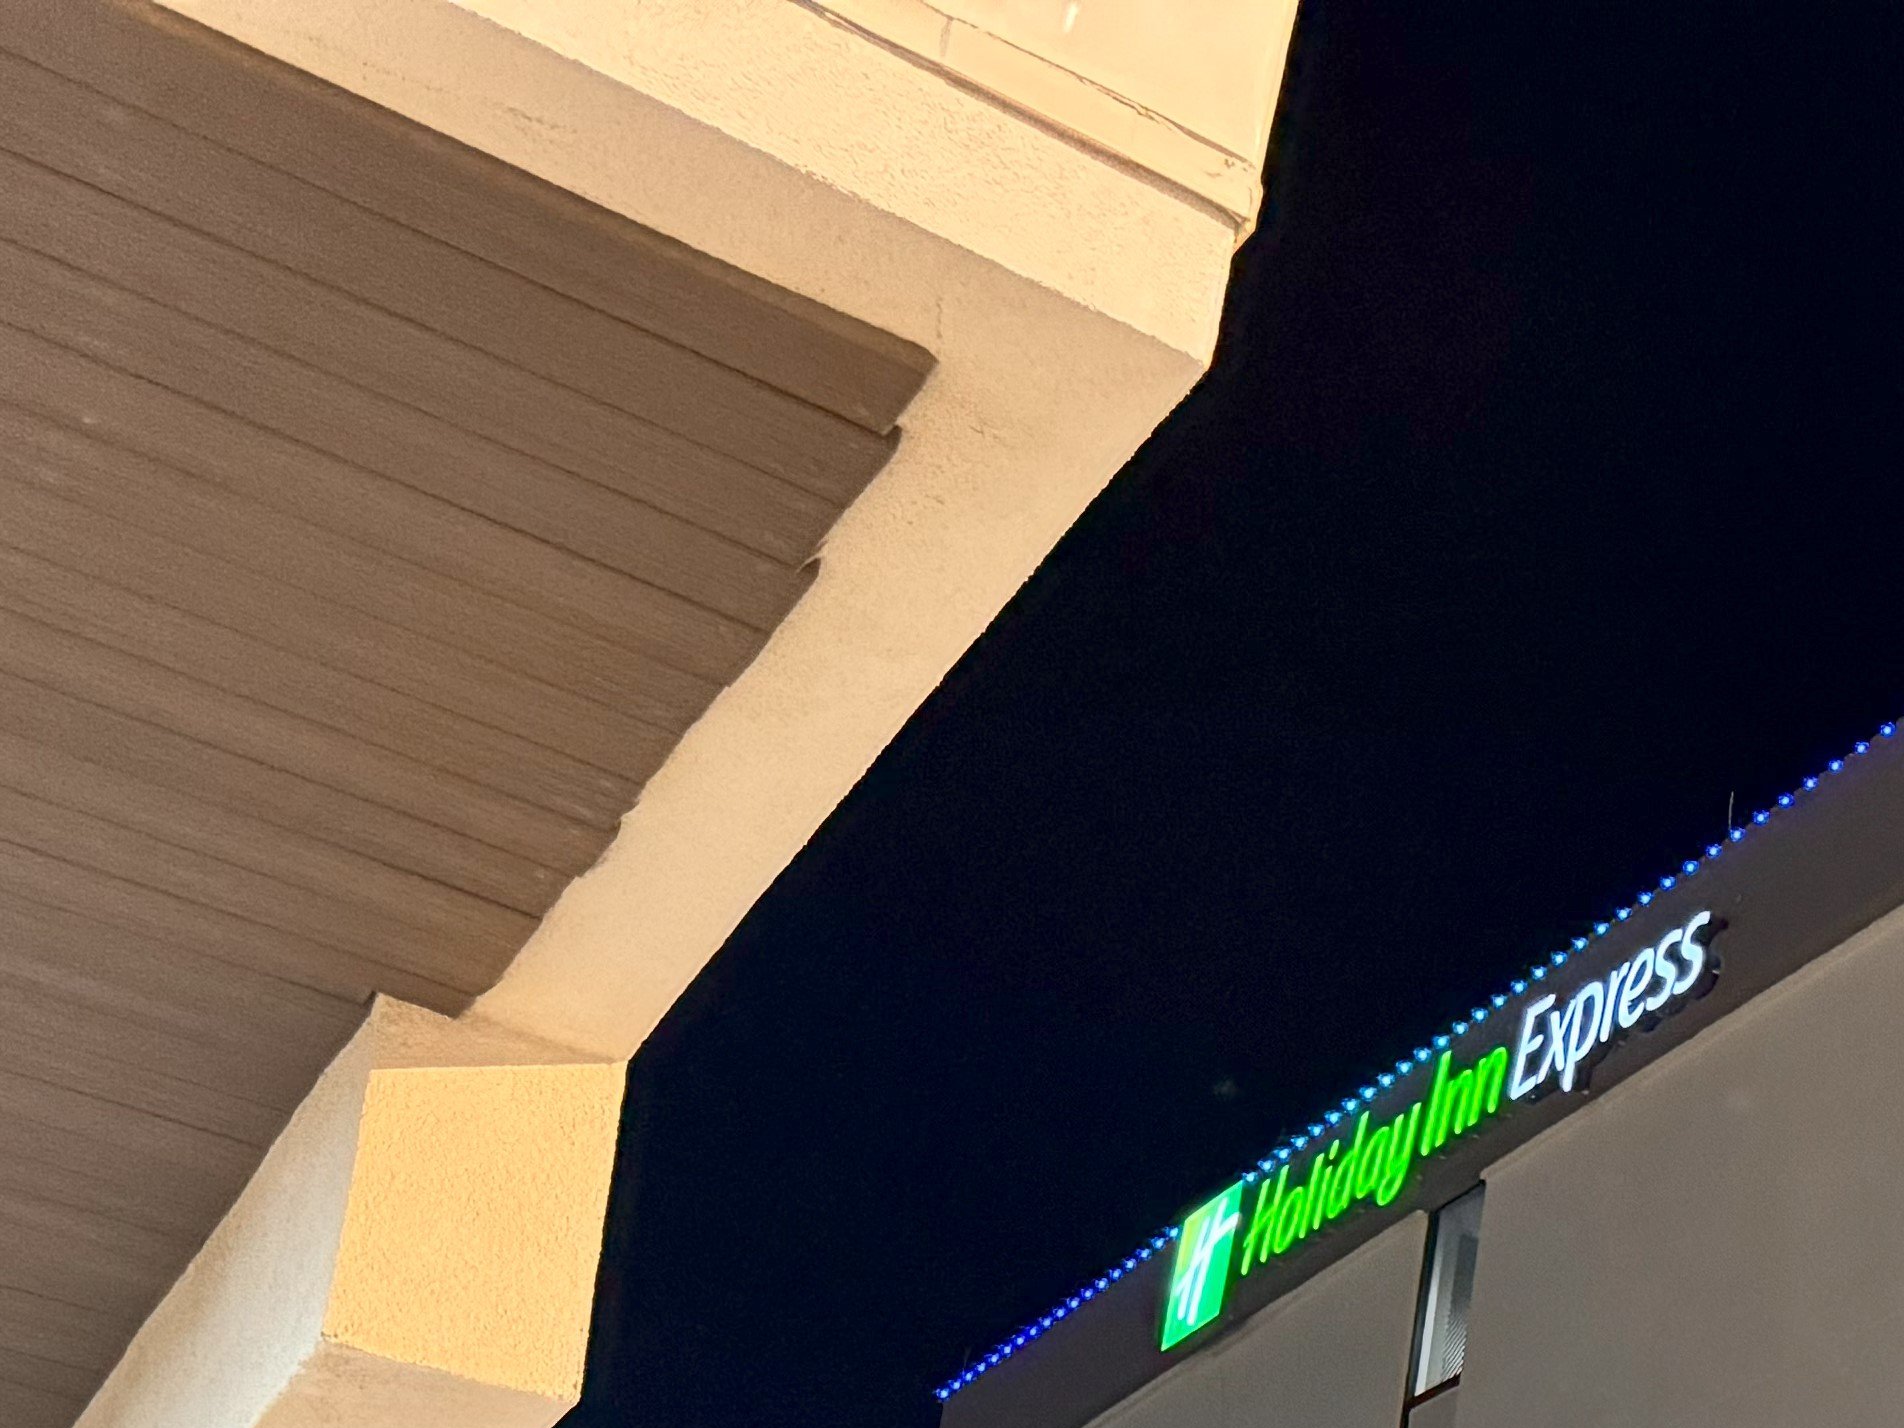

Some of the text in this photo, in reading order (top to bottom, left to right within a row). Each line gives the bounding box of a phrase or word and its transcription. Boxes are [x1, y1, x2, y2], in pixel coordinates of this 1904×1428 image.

[1240, 909, 1712, 1276] Holiday Inn Express
